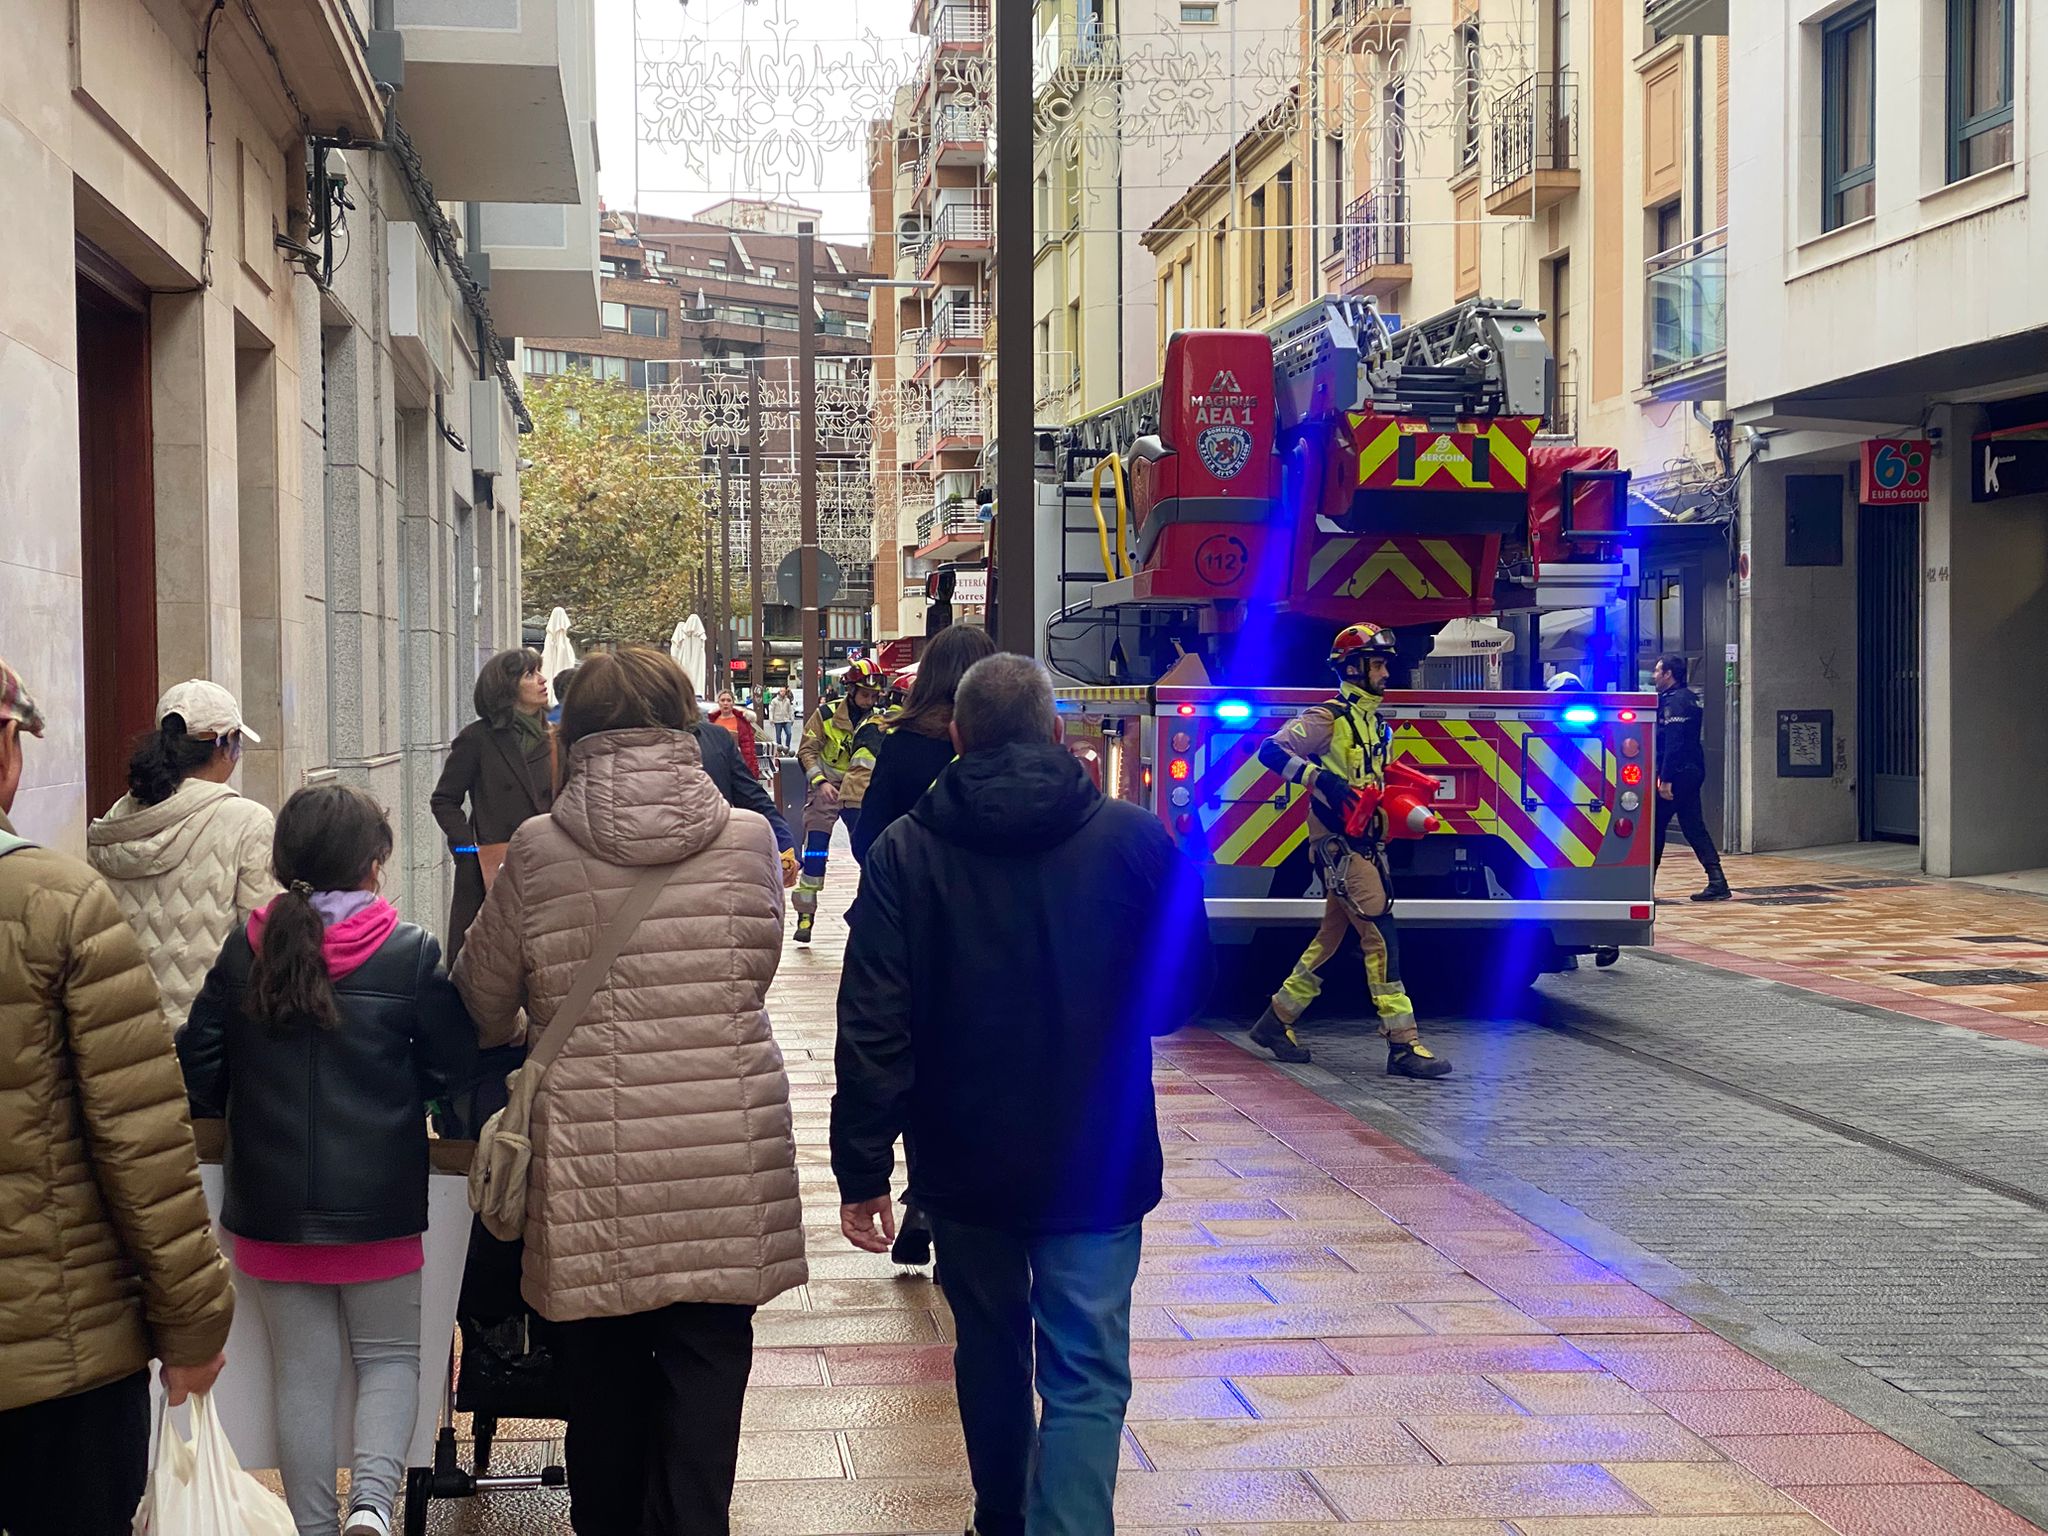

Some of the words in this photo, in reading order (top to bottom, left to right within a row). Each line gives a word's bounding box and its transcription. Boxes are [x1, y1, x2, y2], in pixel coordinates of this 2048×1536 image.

[1191, 396, 1258, 408] MAGIRUS
[1195, 408, 1235, 425] AEA
[1241, 408, 1254, 425] 1
[1420, 453, 1465, 463] SERCOIN
[1871, 490, 1898, 499] EURO
[1900, 489, 1928, 499] 6000
[1204, 552, 1237, 570] 112
[953, 590, 984, 601] Torres
[1471, 639, 1502, 649] Mahou
